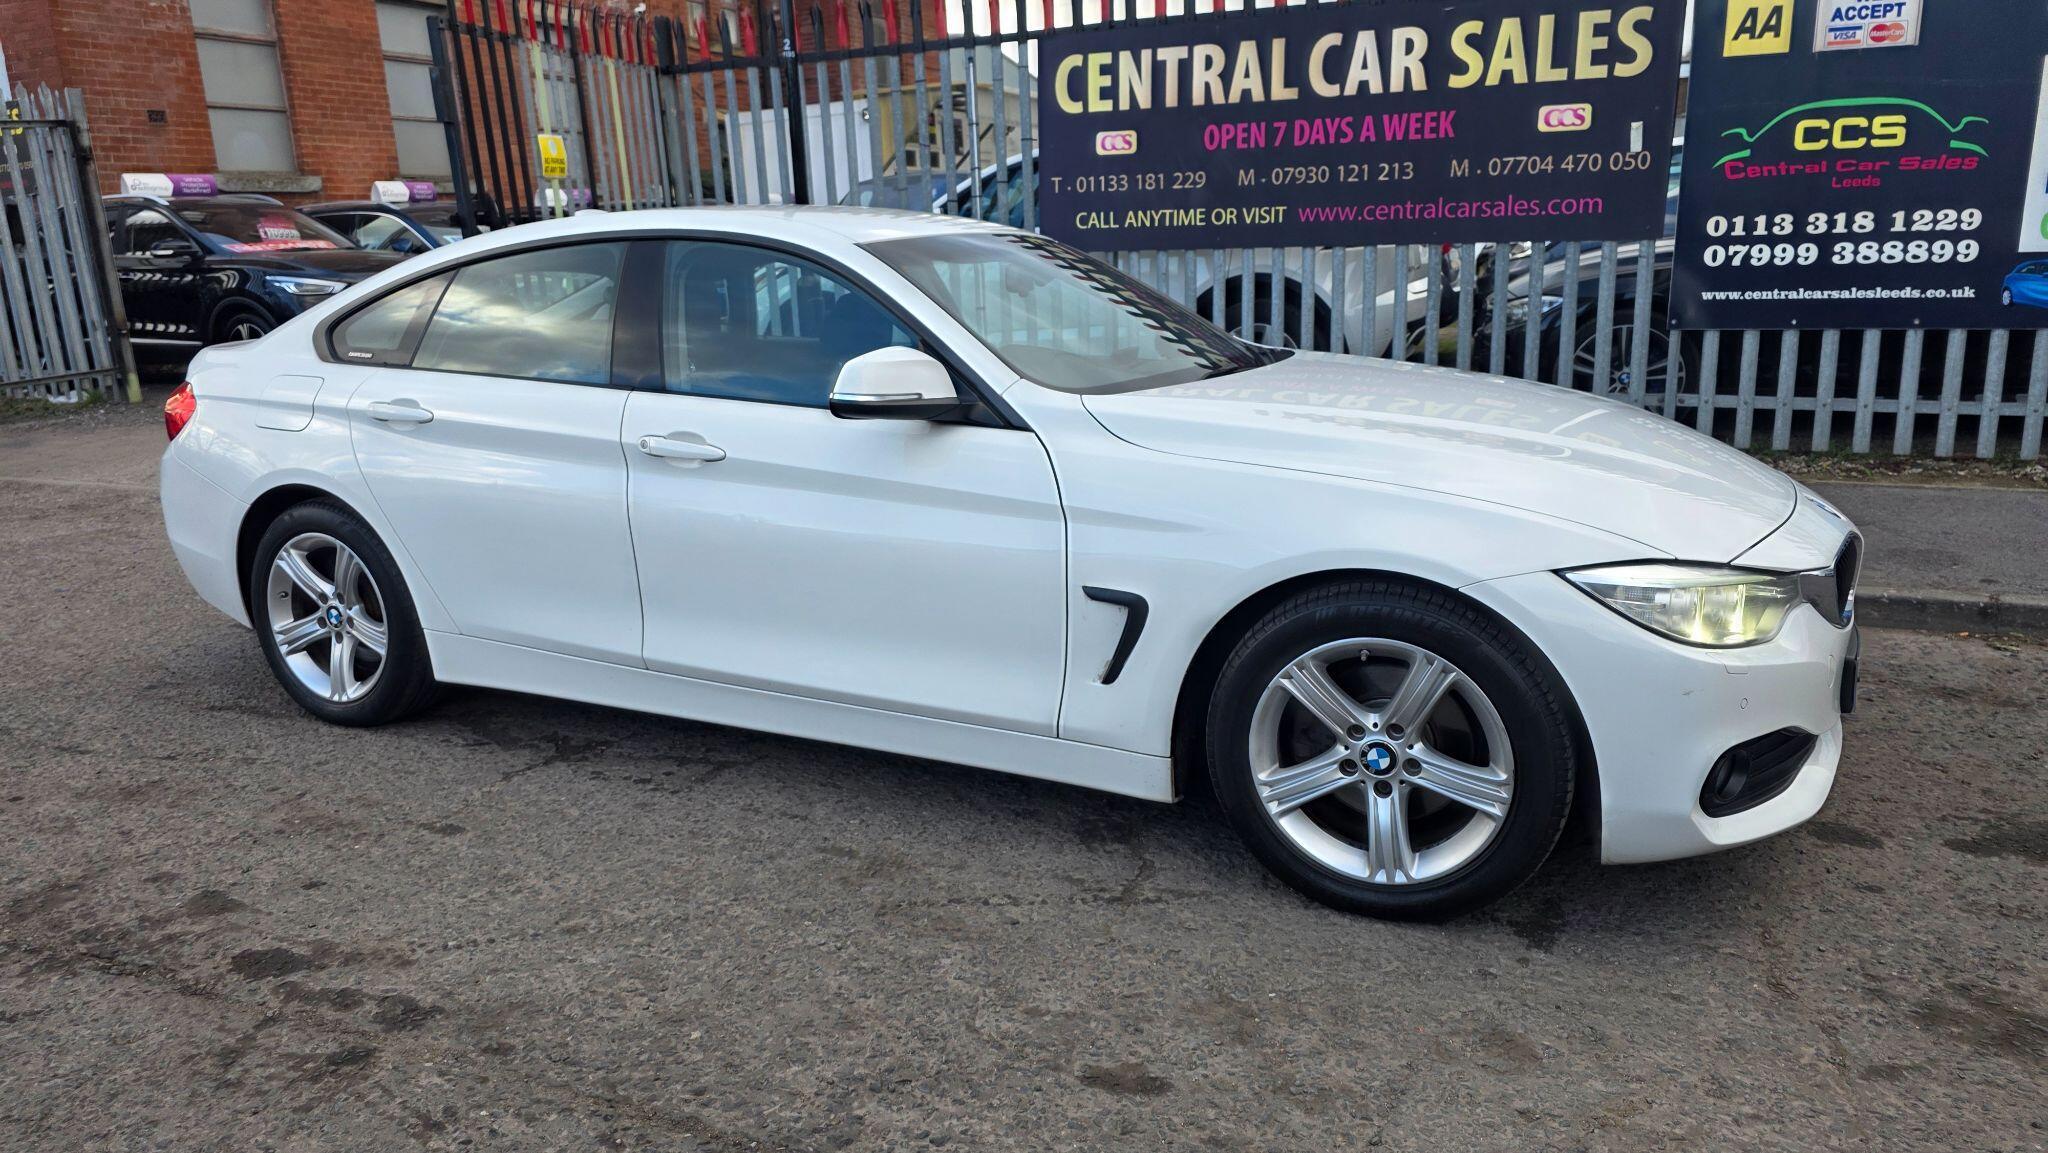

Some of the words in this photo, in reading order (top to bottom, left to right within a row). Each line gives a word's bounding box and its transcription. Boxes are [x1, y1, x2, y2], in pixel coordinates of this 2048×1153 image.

[1732, 5, 1783, 41] AA
[1831, 2, 1906, 22] ACCEPT
[1833, 31, 1856, 40] VISA
[1055, 38, 1298, 114] CENTRAL
[1308, 26, 1428, 98] CAR
[1448, 5, 1654, 89] SALES
[1203, 122, 1266, 151] OPEN
[1273, 121, 1287, 147] 7
[1294, 117, 1354, 146] DAYS
[1360, 115, 1376, 142] A
[1383, 110, 1456, 141] WEEK
[1794, 114, 1907, 151] CCS
[1271, 166, 1329, 185] 07930
[1338, 164, 1369, 182] 121
[1378, 161, 1414, 181] 213
[1488, 153, 1554, 176] 07704
[1561, 153, 1602, 174] 470
[1609, 150, 1650, 172] 050
[1724, 159, 1827, 180] Central
[1836, 158, 1890, 172] Car
[1899, 154, 1980, 170] Sales
[1076, 174, 1129, 193] 01133
[1136, 173, 1165, 190] 181
[1172, 171, 1206, 189] 229
[1831, 174, 1881, 188] Leeds
[1076, 212, 1119, 229] CALL
[1125, 208, 1206, 228] ANYTIME
[1212, 207, 1237, 225] OR
[1243, 206, 1287, 224] VISIT
[1298, 195, 1603, 222] www.centralcarsales.com
[1706, 213, 1794, 237] 0113
[1806, 211, 1875, 234] 318
[1890, 208, 1982, 232] 1229
[1703, 243, 1819, 267] 07999
[1831, 239, 1980, 265] 388899
[1701, 286, 1976, 301] www.centralcarsalesleeds.co.uk
